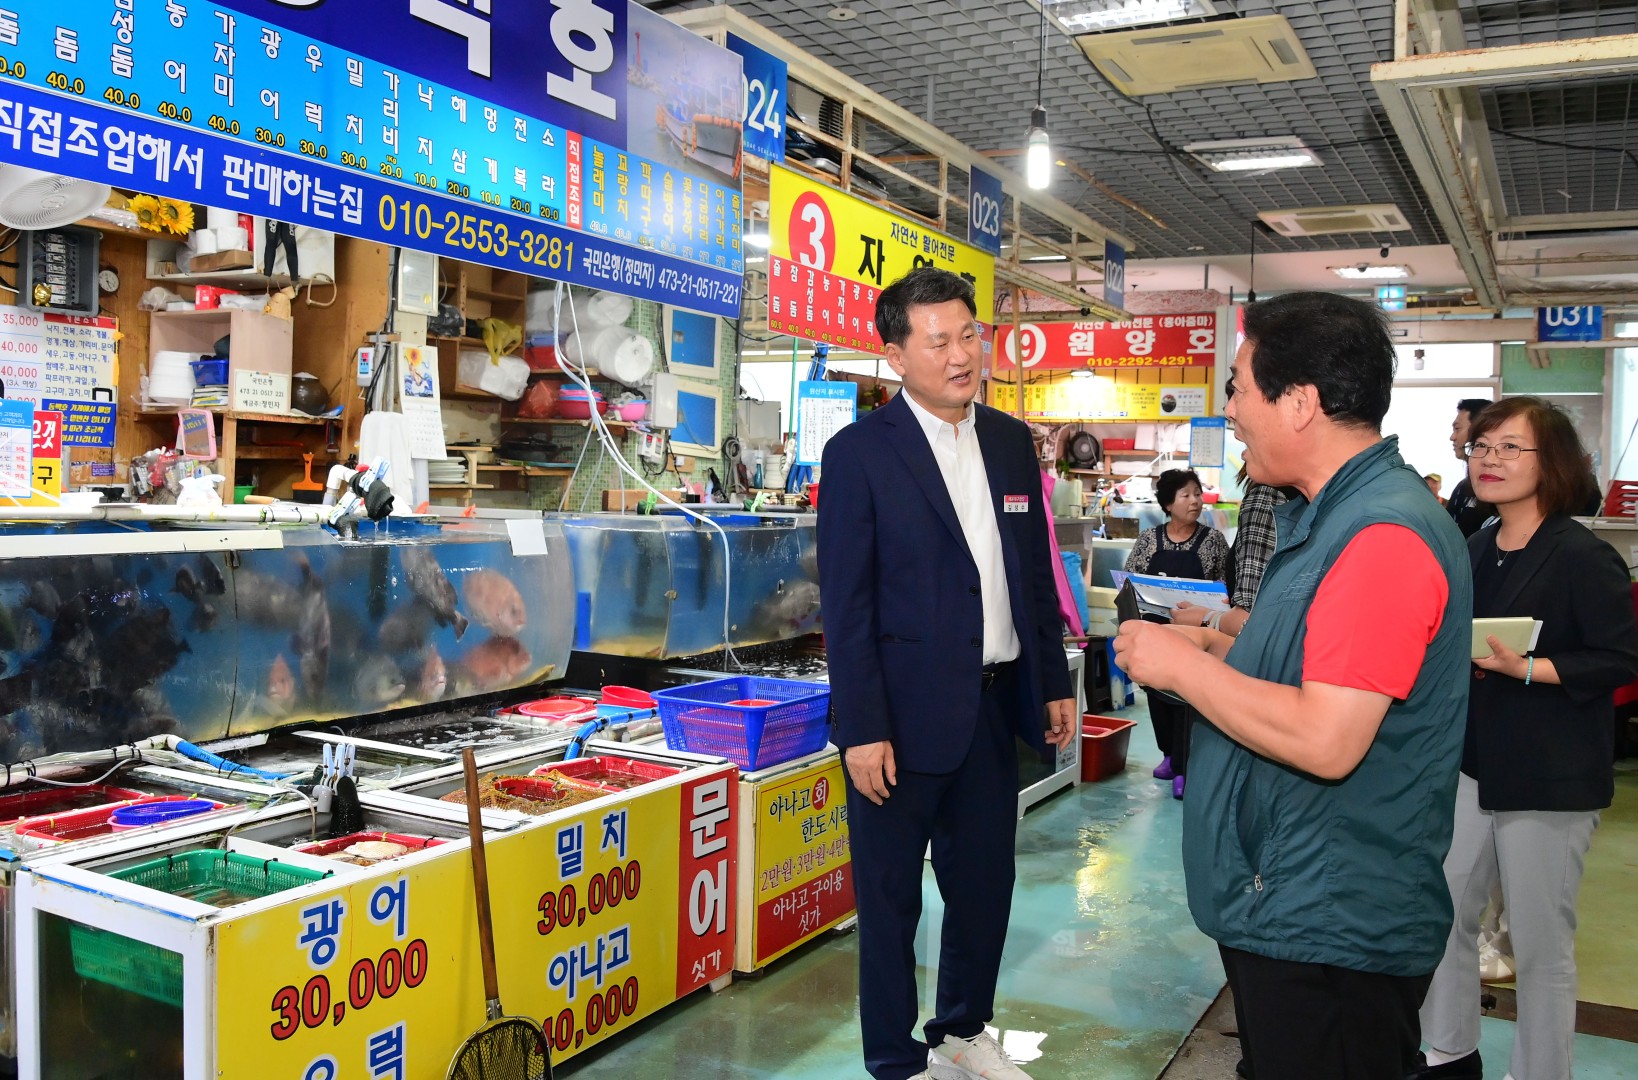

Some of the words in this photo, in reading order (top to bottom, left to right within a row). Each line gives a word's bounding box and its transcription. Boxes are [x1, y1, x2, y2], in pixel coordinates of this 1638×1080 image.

[214, 10, 236, 107] 가자미
[260, 27, 282, 120] 광어
[305, 44, 323, 133] 우럭
[346, 57, 363, 144] 밀치
[383, 70, 400, 155] 가리비
[418, 82, 434, 165] 낙지
[451, 95, 467, 174] 해삼
[46, 71, 85, 95] 40.0
[104, 87, 140, 109] 40.0
[157, 101, 192, 122] 40.0
[208, 115, 240, 136] 40.0
[255, 127, 285, 147] 30.0
[300, 140, 328, 159] 30.0
[341, 152, 367, 170] 30.0
[380, 163, 402, 179] 20.0
[414, 172, 437, 188] 10.0
[447, 181, 470, 198] 20.0
[481, 190, 501, 206] 10.0
[510, 198, 531, 213] 20.0
[540, 206, 559, 220] 20.0
[484, 106, 498, 184] 멍게
[514, 117, 527, 191] 전복
[542, 128, 555, 200] 소라
[0, 101, 203, 190] 직접조업해서
[222, 155, 363, 225] 판매하는집
[379, 195, 573, 271] 010-2553-3281
[583, 248, 655, 289] 국민은행(정민자)
[659, 268, 739, 305] 473-21-0517-221
[569, 139, 580, 225] 직접조업
[699, 183, 709, 245] 다금바리
[972, 192, 999, 236] 023
[715, 189, 725, 250] 이시가리
[800, 203, 826, 272] 3
[891, 222, 918, 248] 자연산
[923, 235, 955, 263] 활어전문
[838, 280, 846, 330] 가자미
[1106, 260, 1123, 293] 022
[1, 341, 38, 354] 40,000
[3, 313, 38, 327] 35,000
[788, 324, 799, 333] 40.0
[804, 328, 815, 338] 40.0
[0, 366, 37, 378] 40,000
[252, 377, 273, 387] 국민은행
[1087, 356, 1193, 367] 010-2292-4291
[769, 787, 811, 822] 아나고
[557, 808, 626, 879] 밀치
[689, 778, 728, 937] 문어
[300, 879, 406, 967] 광어
[537, 860, 641, 936] 30,000
[773, 889, 808, 921] 아나고
[812, 869, 844, 903] 구이용
[798, 905, 821, 936] 싯가
[271, 938, 428, 1041] 30,000
[548, 925, 629, 999] 아나고
[692, 948, 722, 984] 싯가
